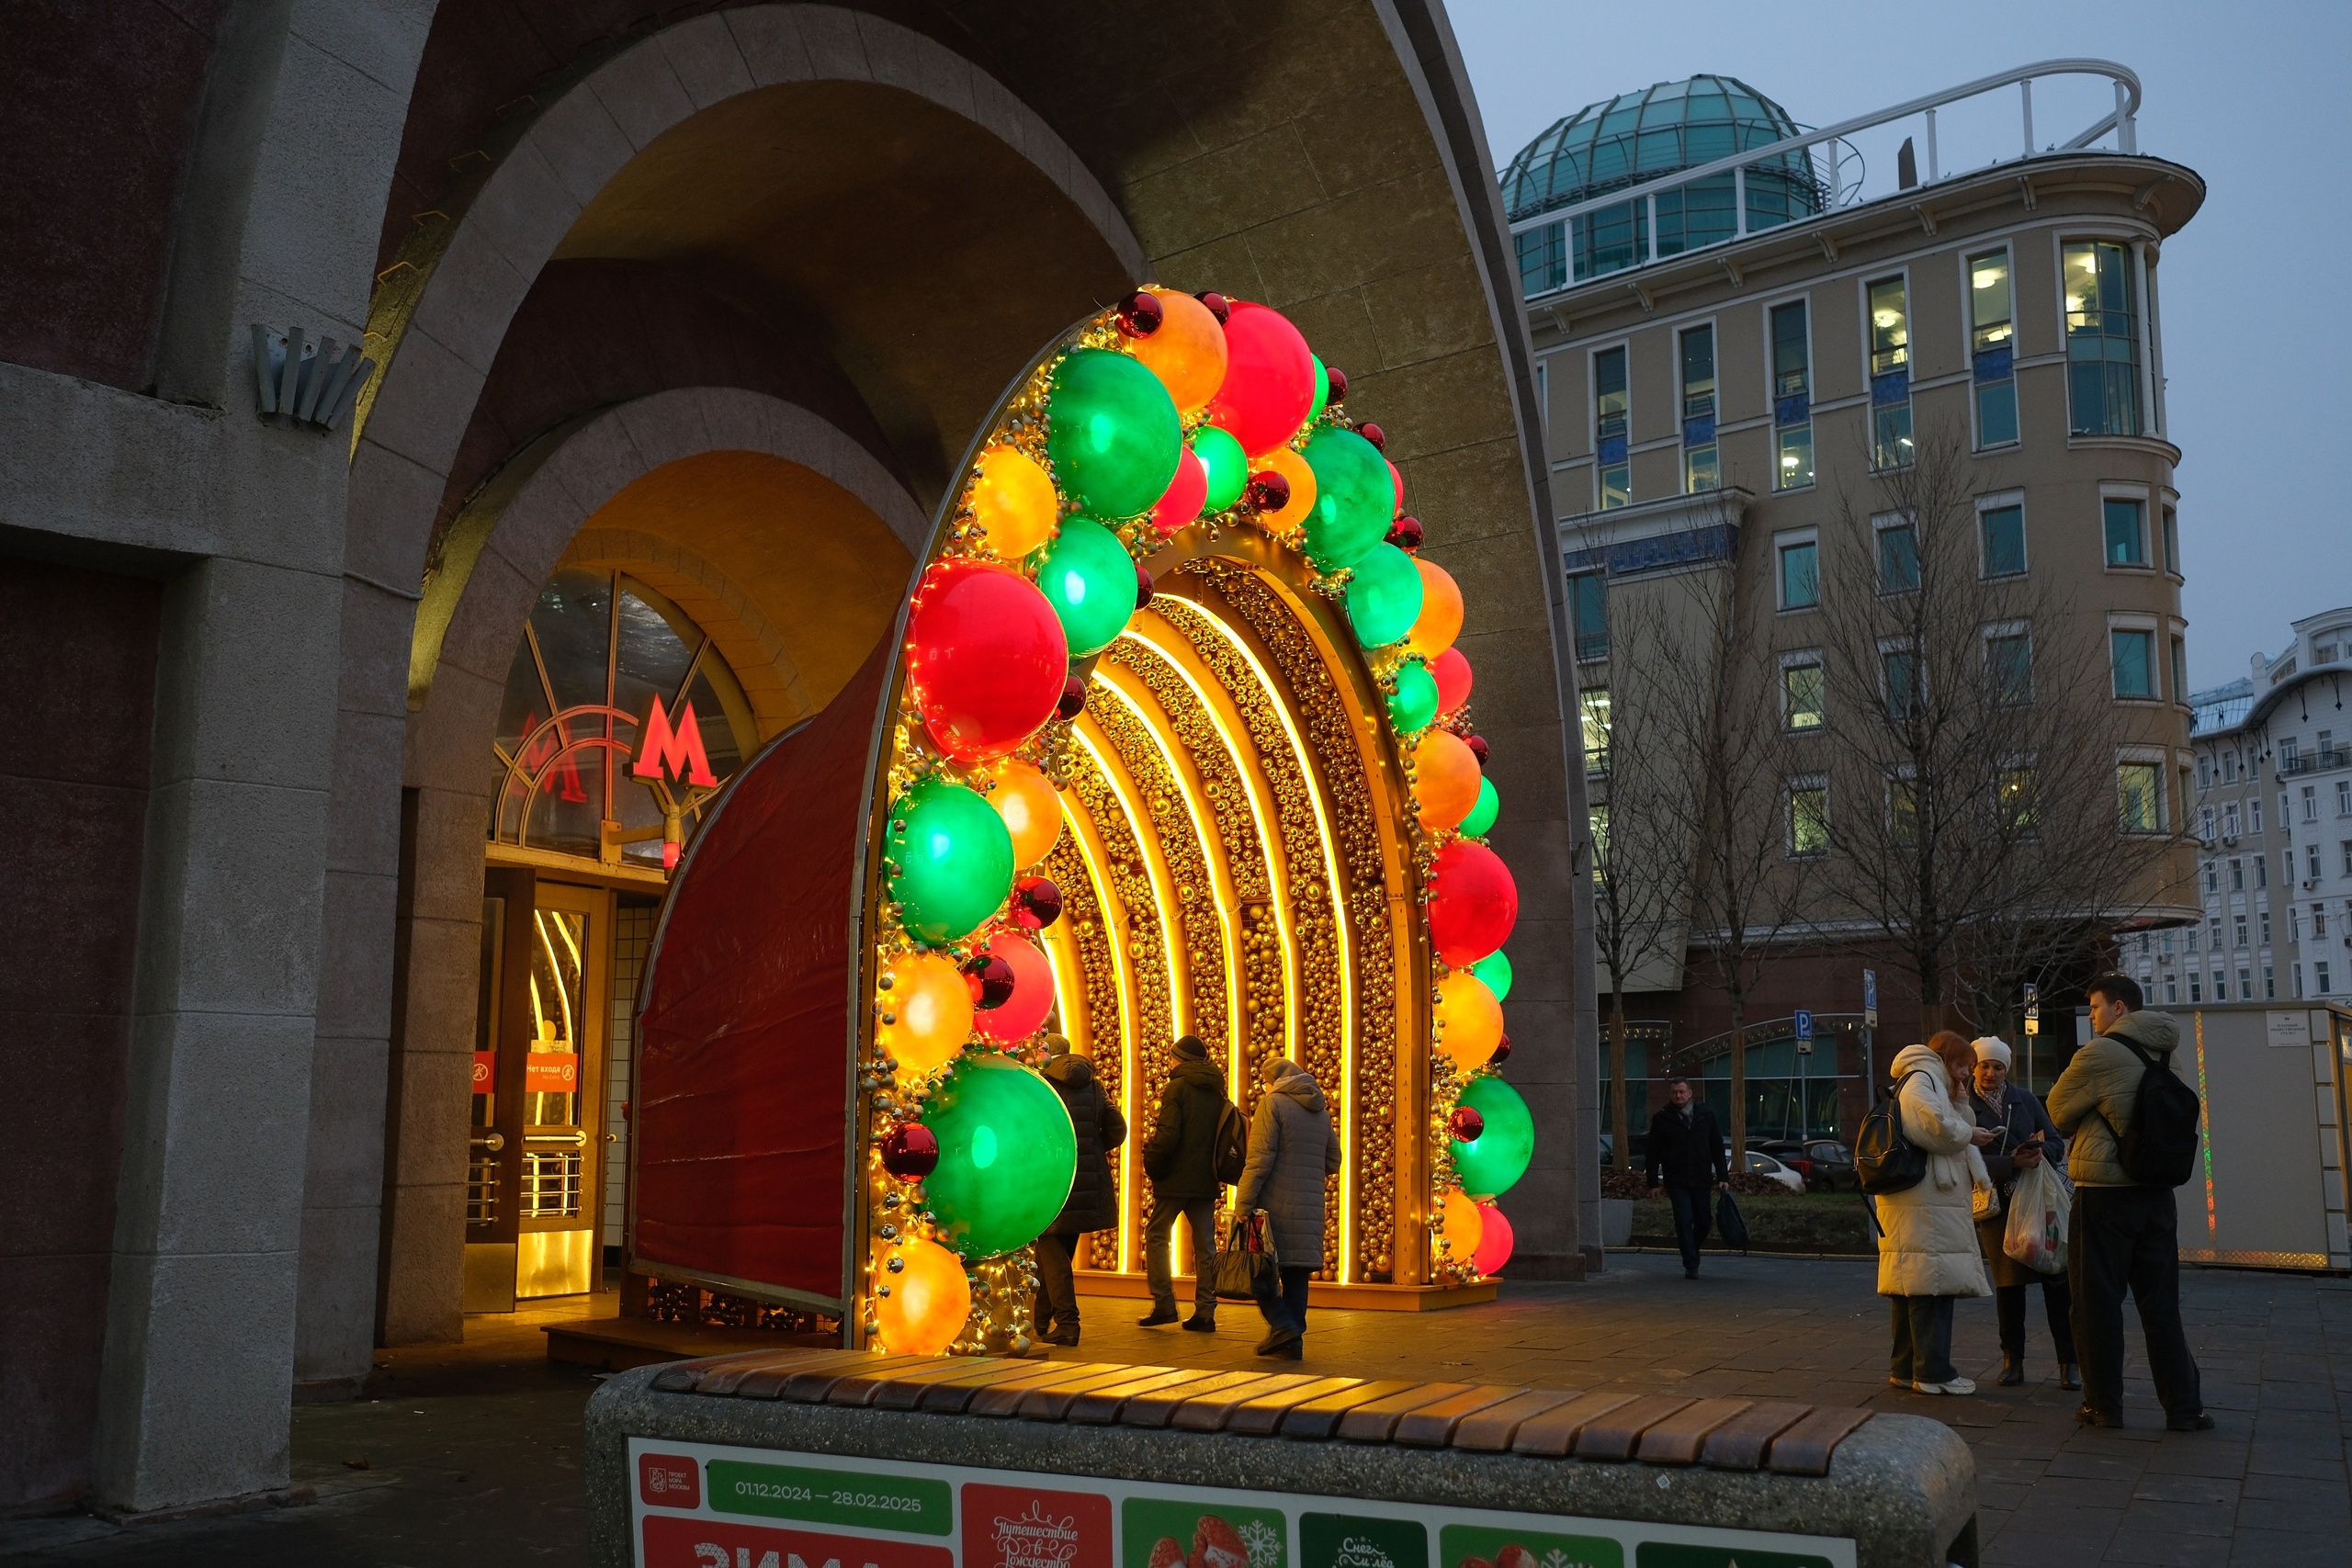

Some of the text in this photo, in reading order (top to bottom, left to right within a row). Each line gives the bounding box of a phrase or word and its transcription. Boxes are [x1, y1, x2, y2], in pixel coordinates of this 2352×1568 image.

[633, 692, 718, 788] М
[1867, 974, 1874, 1004] P
[1799, 1013, 1809, 1036] P
[526, 1064, 561, 1075] Нет входа
[668, 1471, 687, 1479] ПРОЕКТ
[735, 1481, 812, 1501] 01.12.2024
[831, 1491, 922, 1513] 28.02.2025
[991, 1516, 1079, 1541] Путешествие
[1342, 1537, 1385, 1555] Снег
